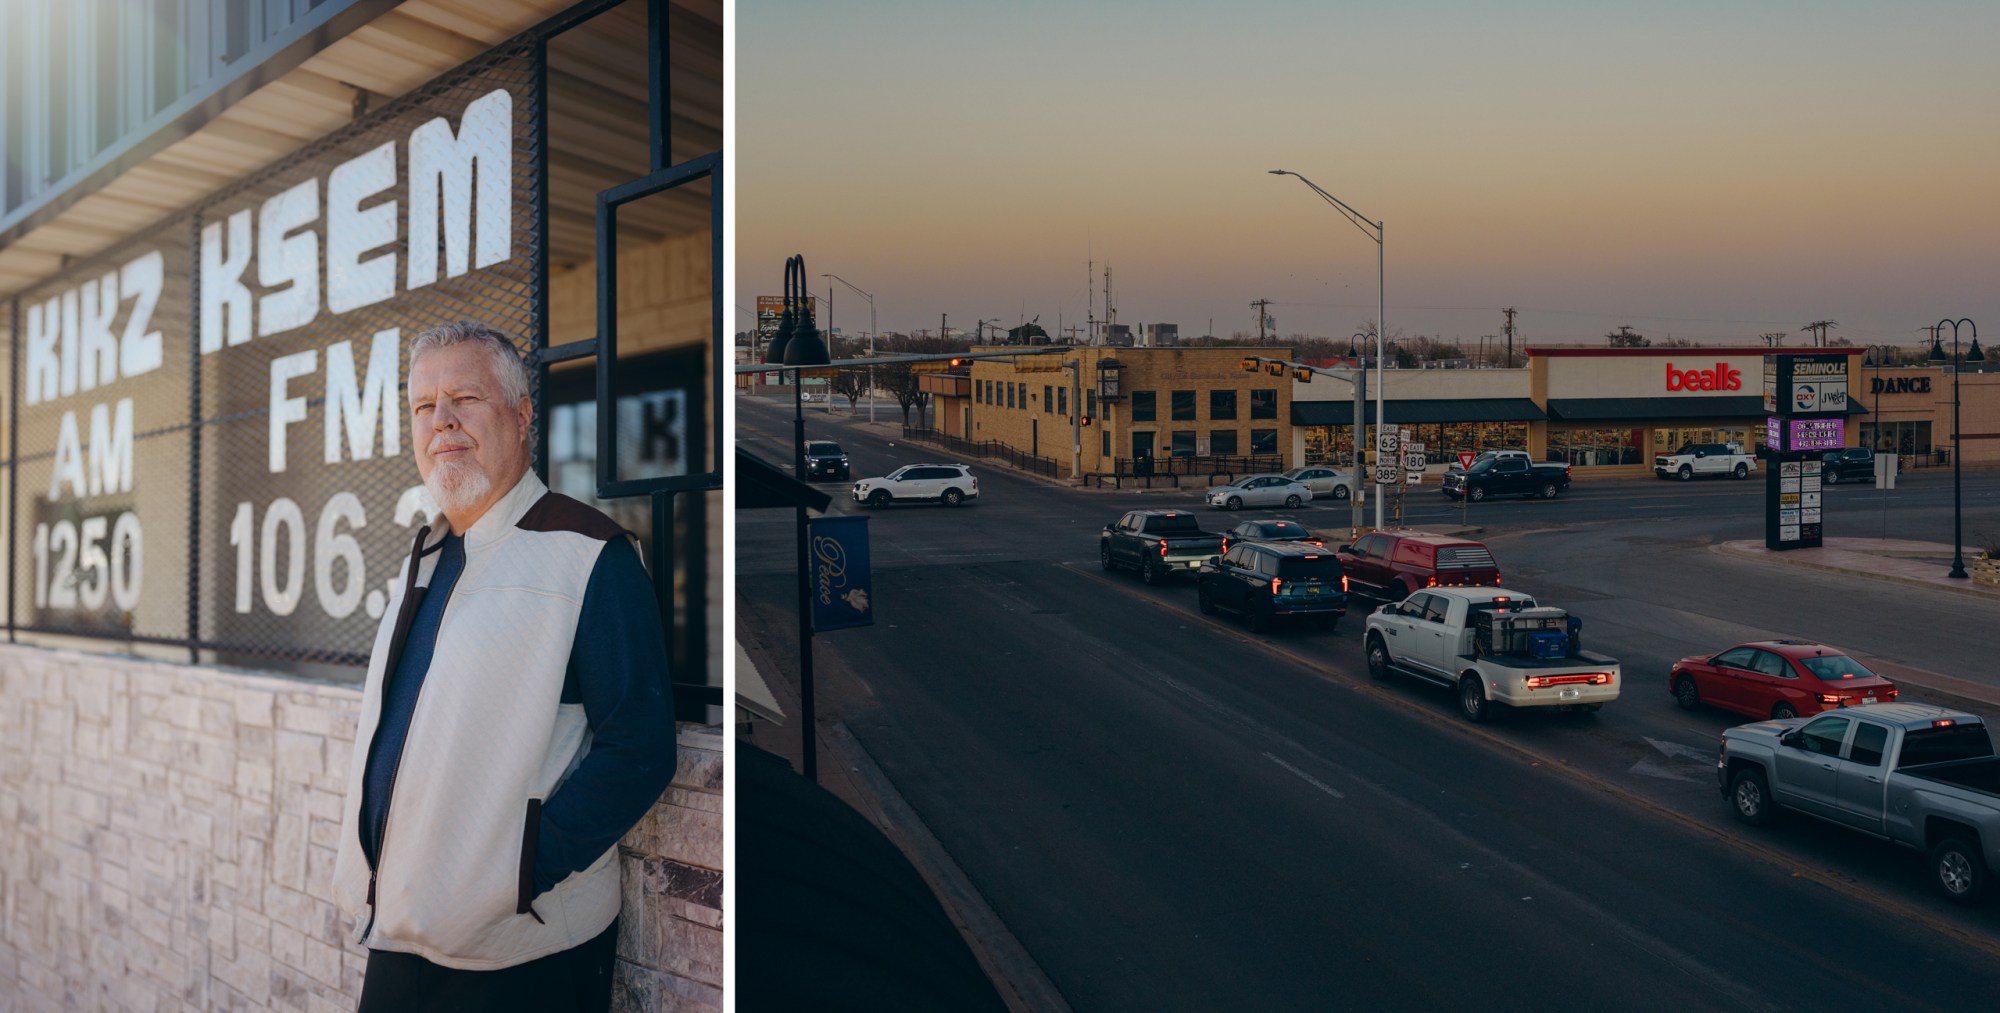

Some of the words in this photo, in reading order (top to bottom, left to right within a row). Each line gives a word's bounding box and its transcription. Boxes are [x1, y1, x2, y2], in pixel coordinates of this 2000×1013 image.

[200, 88, 513, 355] KSEM
[26, 250, 164, 407] KIKZ
[1666, 362, 1742, 391] bealls
[1793, 363, 1846, 374] SEMINOLE
[1870, 376, 1931, 394] DANCE
[268, 327, 402, 474] FM
[1796, 393, 1816, 401] OXY
[49, 398, 134, 500] AM
[641, 397, 679, 462] K
[1381, 438, 1396, 448] 62
[1377, 470, 1396, 480] 385
[1407, 457, 1424, 467] 180
[33, 510, 144, 612] 1250
[813, 535, 847, 606] Peace
